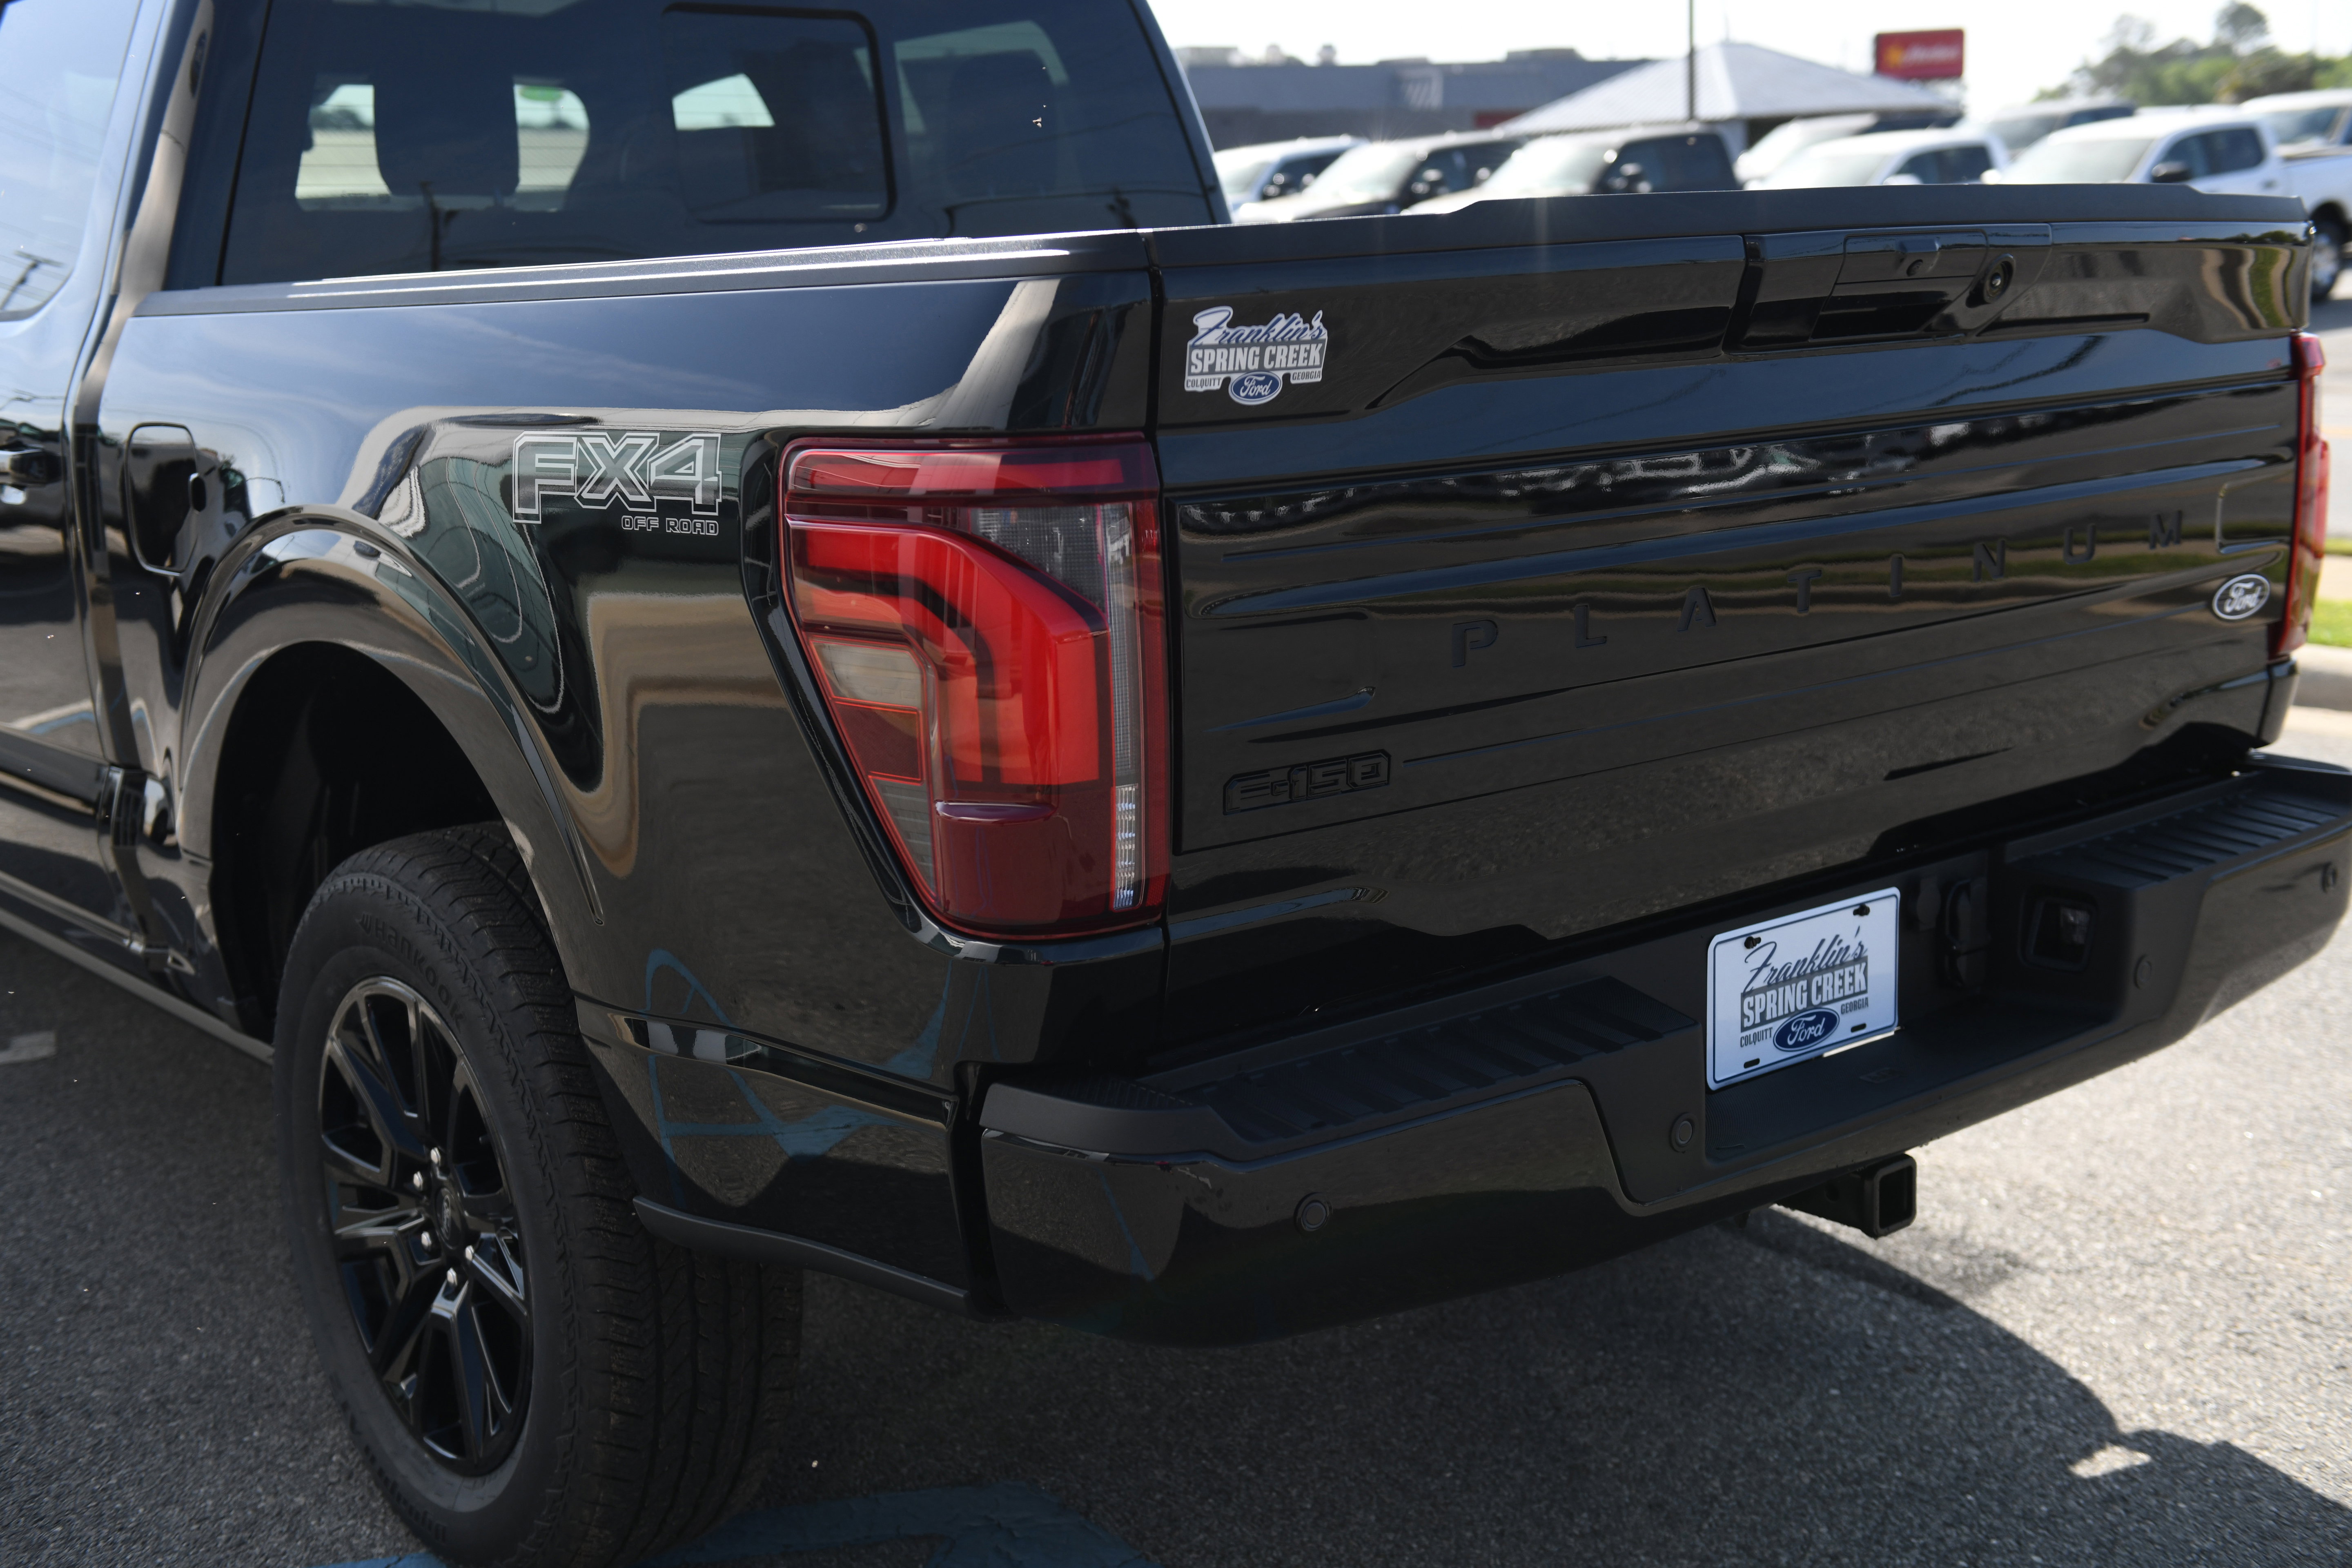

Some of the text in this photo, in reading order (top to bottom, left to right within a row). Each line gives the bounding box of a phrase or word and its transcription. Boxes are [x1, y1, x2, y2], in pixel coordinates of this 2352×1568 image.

[1191, 309, 1326, 347] Franklin's
[1191, 343, 1323, 374] SPRING CREEK
[1186, 377, 1222, 388] COLQUITT
[1239, 375, 1272, 397] Ford
[1292, 370, 1321, 380] GEORGIA
[512, 431, 722, 524] FX4
[621, 515, 719, 536] OFF ROAD
[1452, 510, 2183, 668] PLATINUM
[2224, 581, 2263, 613] Ford
[1224, 750, 1390, 814] F-150
[1742, 925, 1868, 997] Franklin's
[1744, 962, 1867, 1028] SPRING CREEK
[1841, 997, 1869, 1015] GEORGIA
[1740, 1027, 1773, 1048] COLQUITT
[1787, 1014, 1826, 1046] Ford
